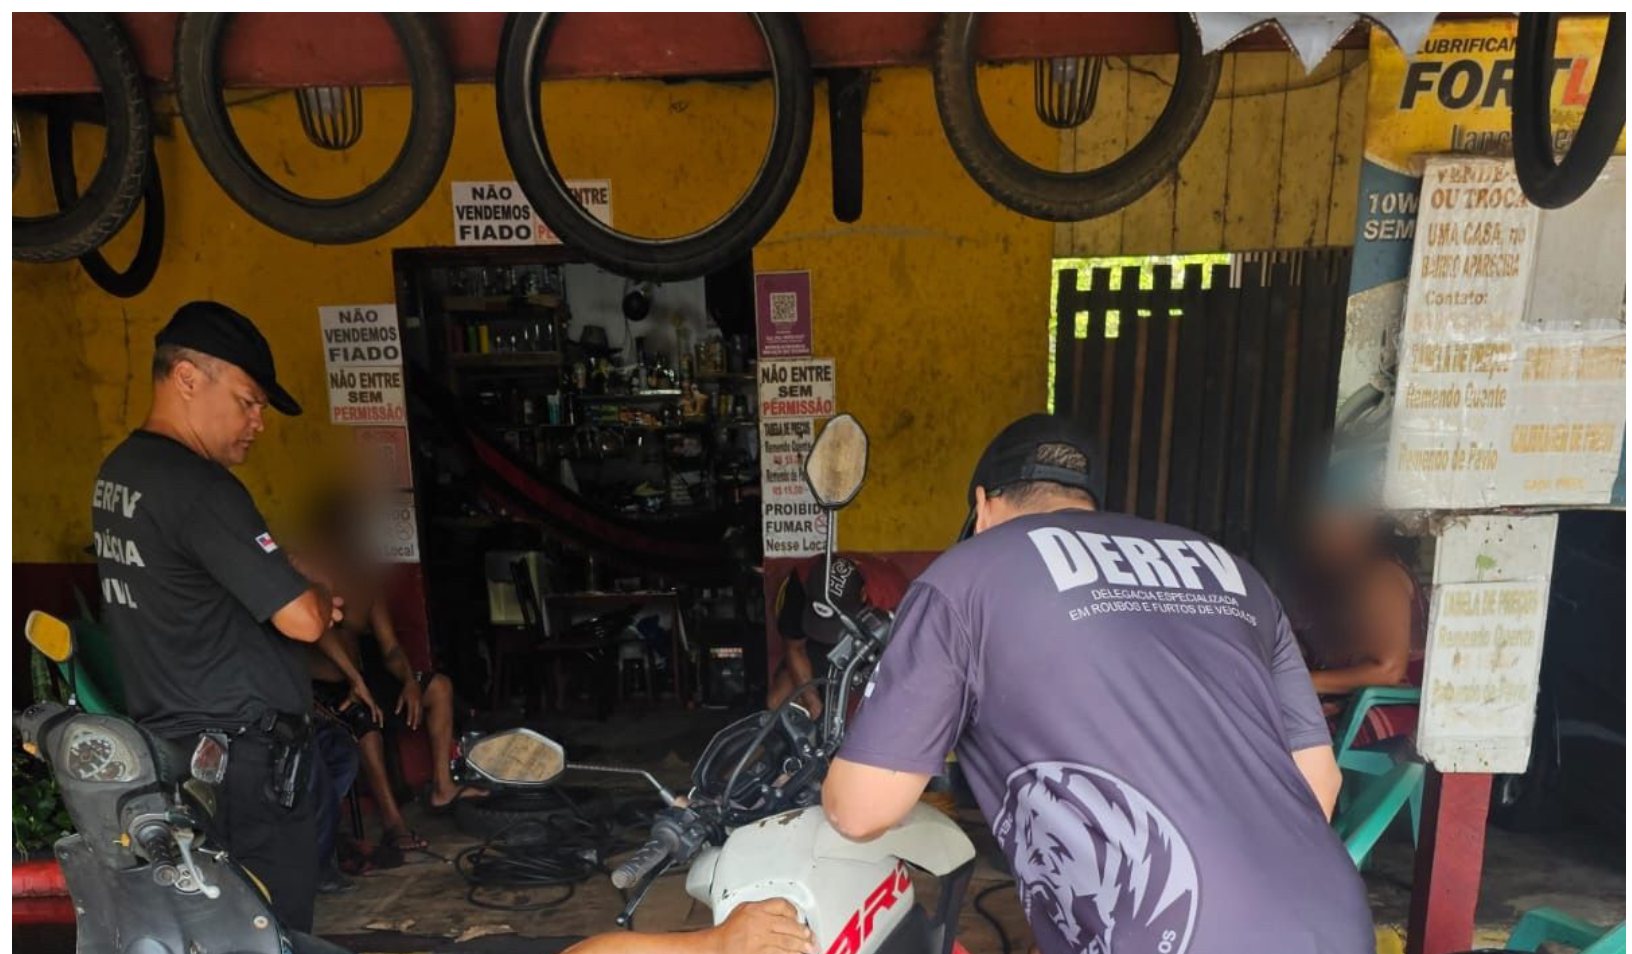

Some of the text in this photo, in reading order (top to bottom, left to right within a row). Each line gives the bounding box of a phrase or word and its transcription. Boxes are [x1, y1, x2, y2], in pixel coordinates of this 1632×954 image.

[1417, 37, 1518, 54] UBRIFICA
[472, 184, 512, 200] NÃO
[569, 187, 608, 205] NTRE
[1431, 187, 1529, 209] OU TROCA
[1368, 192, 1418, 214] 10W
[456, 205, 530, 220] VENDEMOS
[459, 225, 531, 240] FIADO
[1363, 219, 1415, 240] SEM
[1427, 221, 1459, 247] UMA
[338, 308, 378, 323] NÃO
[324, 326, 397, 343] VENDEMOS
[328, 346, 399, 362] FIADO
[330, 370, 400, 389] NÃO ENTRE
[761, 363, 832, 383] NÃO ENTRE
[348, 391, 383, 403] SEM
[779, 385, 812, 398] SEM
[334, 403, 403, 420] PERMISSÃO
[763, 398, 832, 415] PERMISSÃO
[93, 480, 142, 518] ERFV
[766, 521, 813, 533] FUMAR
[766, 538, 828, 551] Nesse Loca
[1027, 526, 1247, 596] DERFV
[1091, 589, 1239, 606] DELEGACIA ESPECIALIZADA
[1069, 609, 1091, 621] EM
[1092, 601, 1141, 614] ROUBOS
[1142, 602, 1151, 612] E
[1152, 602, 1196, 614] FURTOS
[1198, 604, 1214, 614] DE
